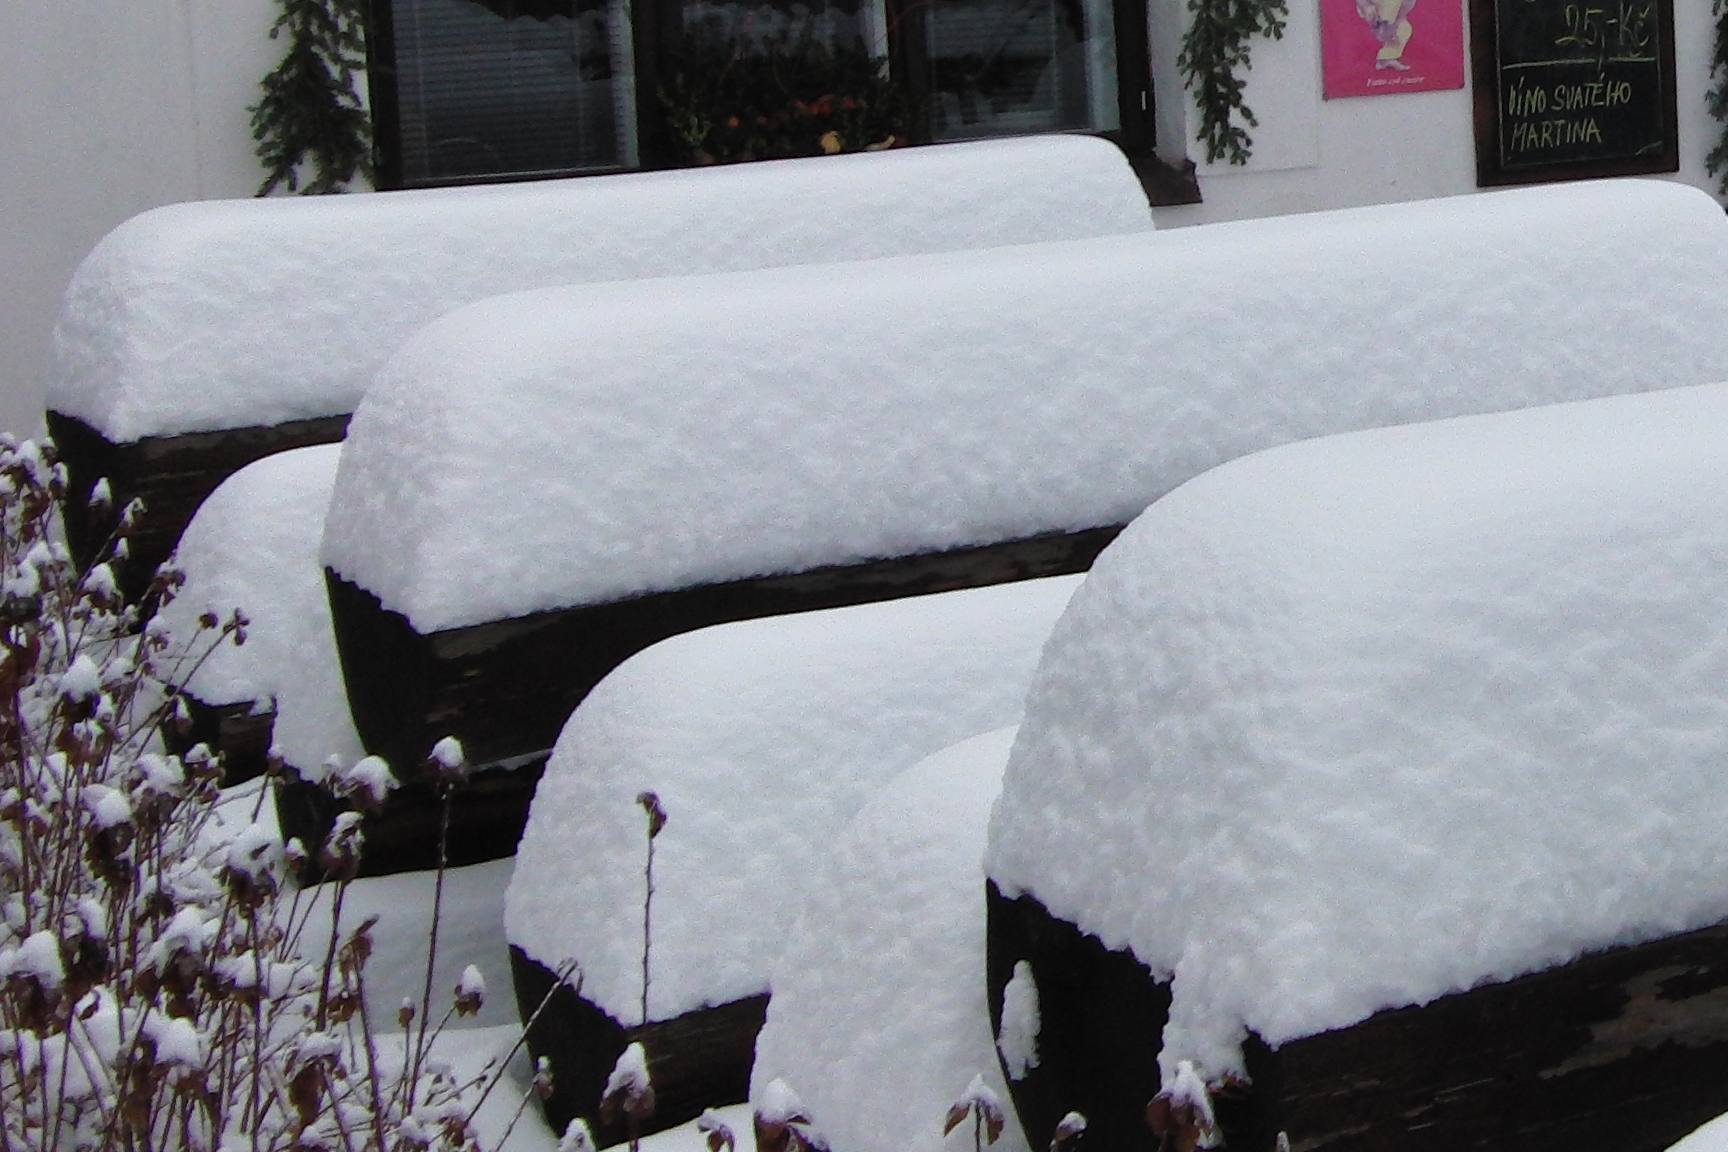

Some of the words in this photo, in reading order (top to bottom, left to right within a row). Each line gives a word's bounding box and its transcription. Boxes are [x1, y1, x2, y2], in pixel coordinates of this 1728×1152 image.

[1508, 74, 1546, 118] VÍNO
[1551, 71, 1632, 111] SVATÉHO
[1510, 116, 1603, 153] MARTINA
